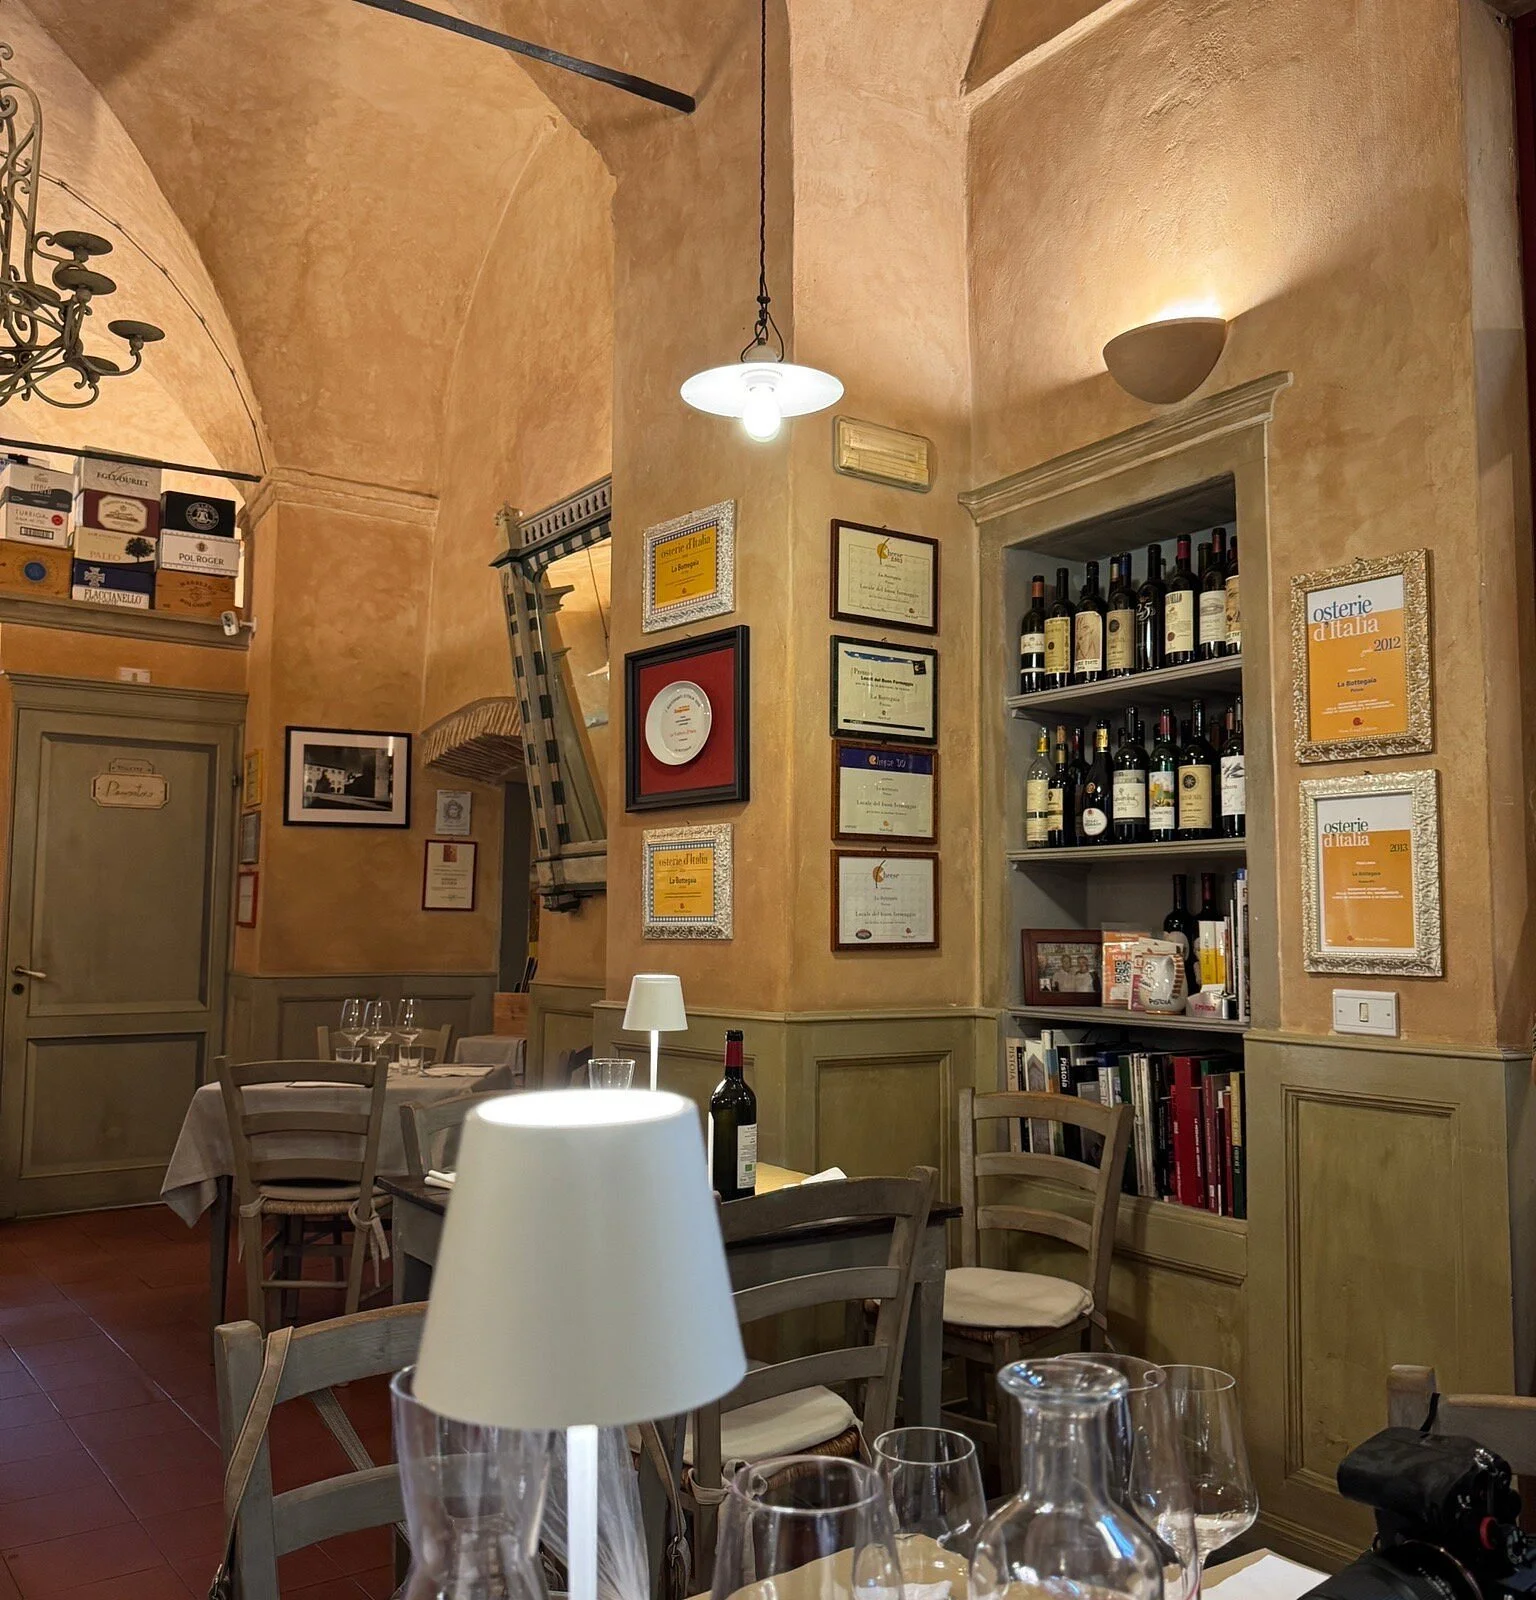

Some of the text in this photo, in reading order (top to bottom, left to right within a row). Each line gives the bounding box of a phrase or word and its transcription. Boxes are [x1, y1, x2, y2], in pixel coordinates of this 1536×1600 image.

[660, 533, 711, 559] osterie d'Italia
[179, 552, 225, 565] POL ROGER
[84, 589, 143, 604] FLACCIANELLO
[1313, 594, 1373, 623] osterie
[1313, 614, 1380, 642] d'Italia
[1373, 635, 1401, 652] 2012
[1345, 677, 1377, 687] Bottegaia
[1324, 817, 1369, 834] osterie
[1324, 832, 1370, 848] d'Italia
[1389, 843, 1409, 853] 2013
[659, 852, 708, 867] osterie d'Italia
[1060, 1057, 1068, 1089] Pistoia
